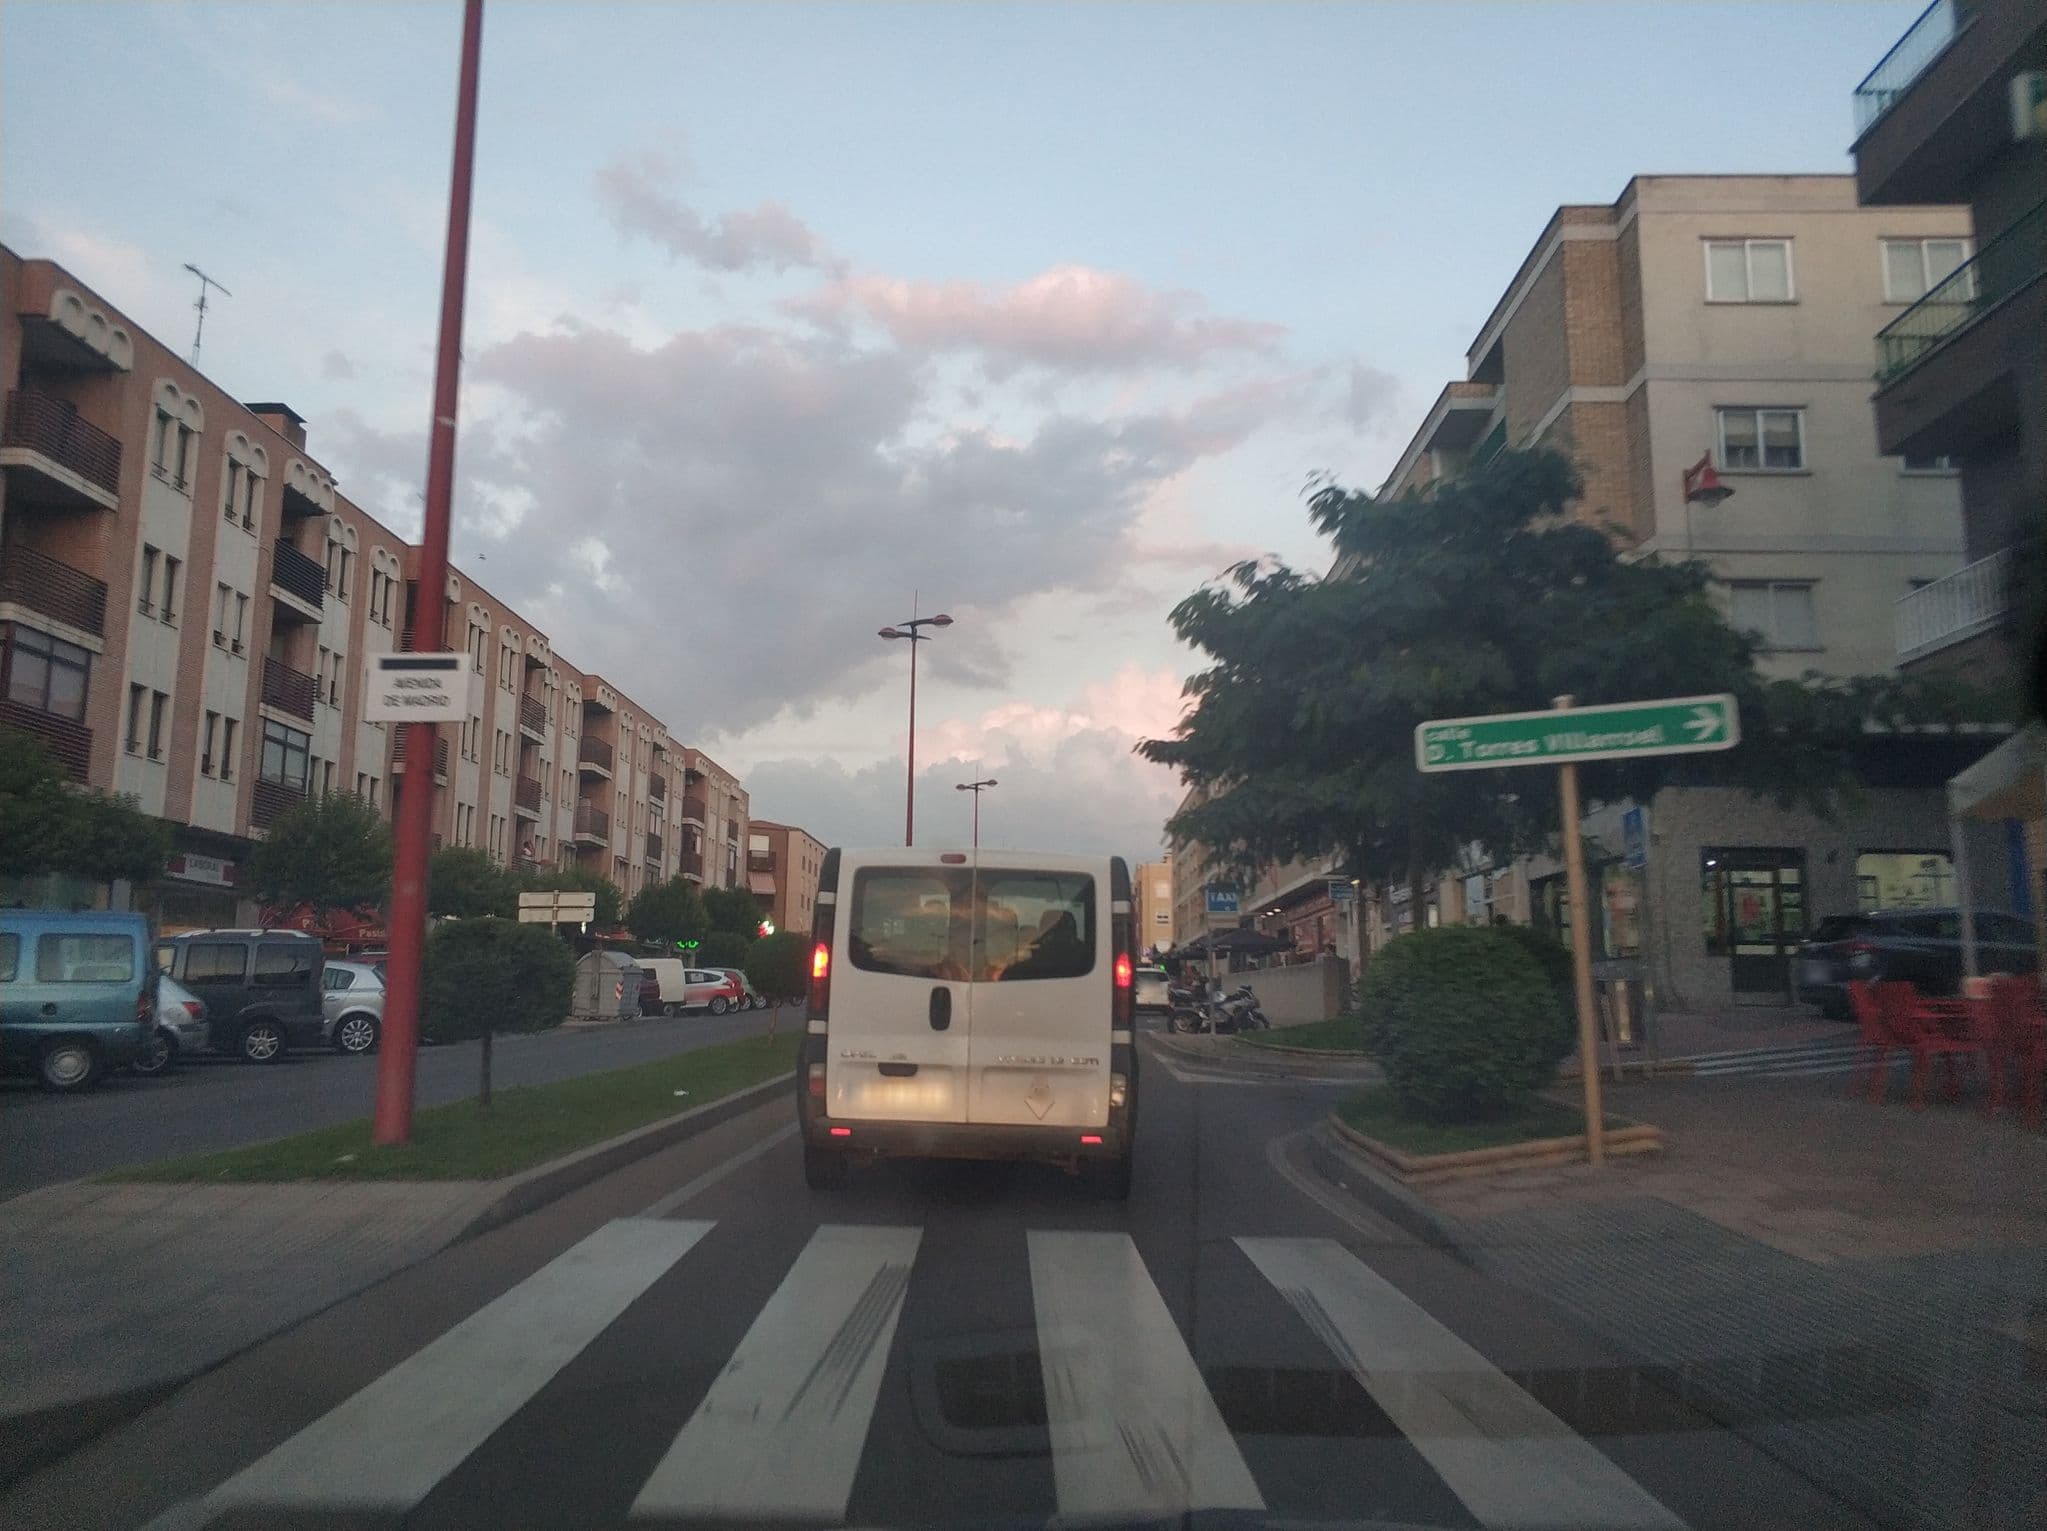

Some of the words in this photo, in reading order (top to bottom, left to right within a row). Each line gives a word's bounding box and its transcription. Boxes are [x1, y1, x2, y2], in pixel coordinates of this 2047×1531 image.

[383, 694, 400, 707] DE
[402, 694, 451, 707] MADRID
[1457, 739, 1539, 760] Torres
[1209, 891, 1237, 903] TAXI
